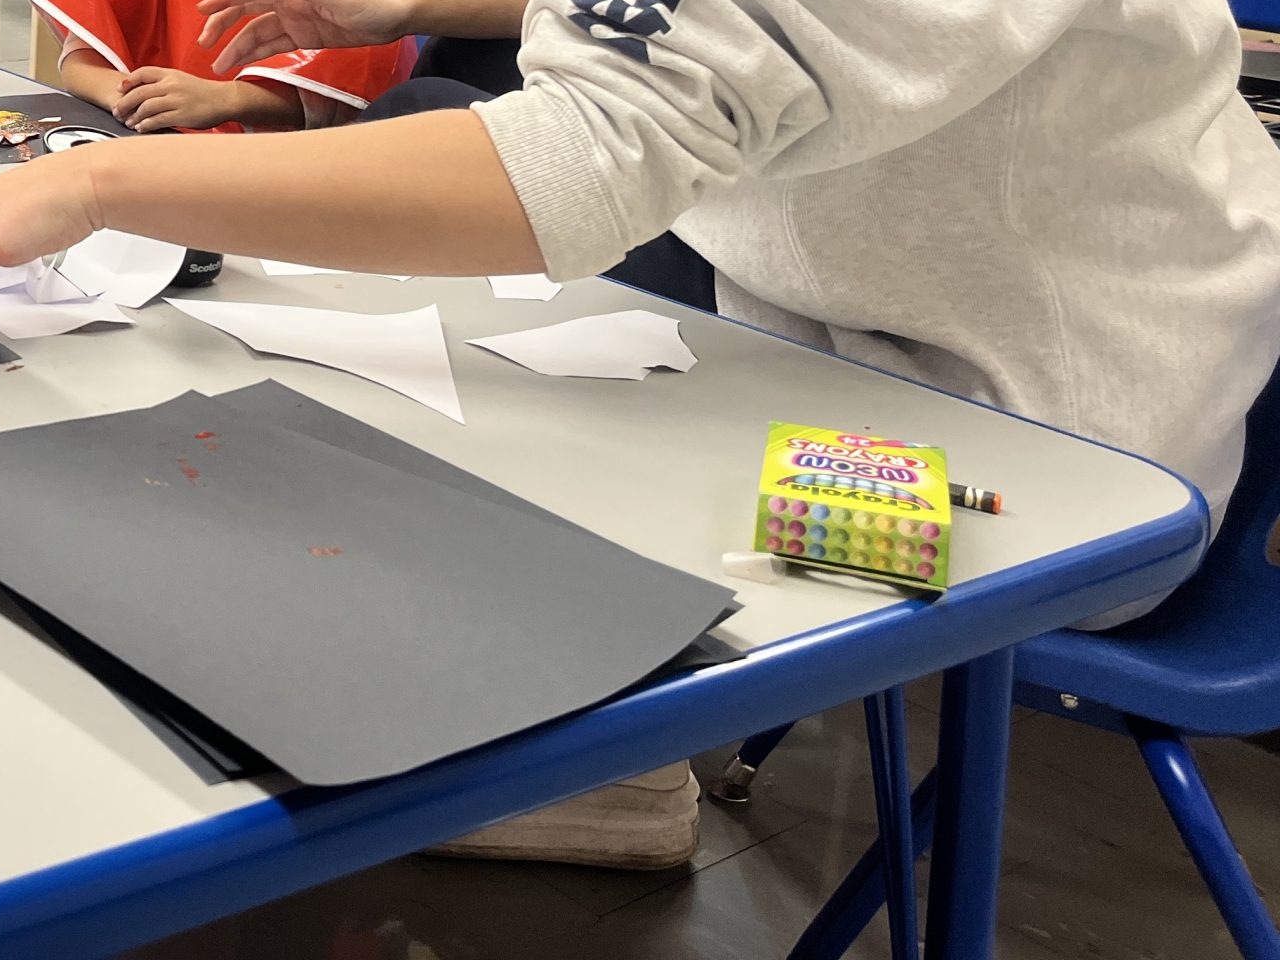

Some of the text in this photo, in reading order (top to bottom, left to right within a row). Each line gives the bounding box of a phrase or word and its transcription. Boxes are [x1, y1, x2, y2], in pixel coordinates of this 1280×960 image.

[787, 438, 928, 469] CRAYONS
[799, 454, 910, 482] NEON
[790, 483, 921, 511] Crayola
